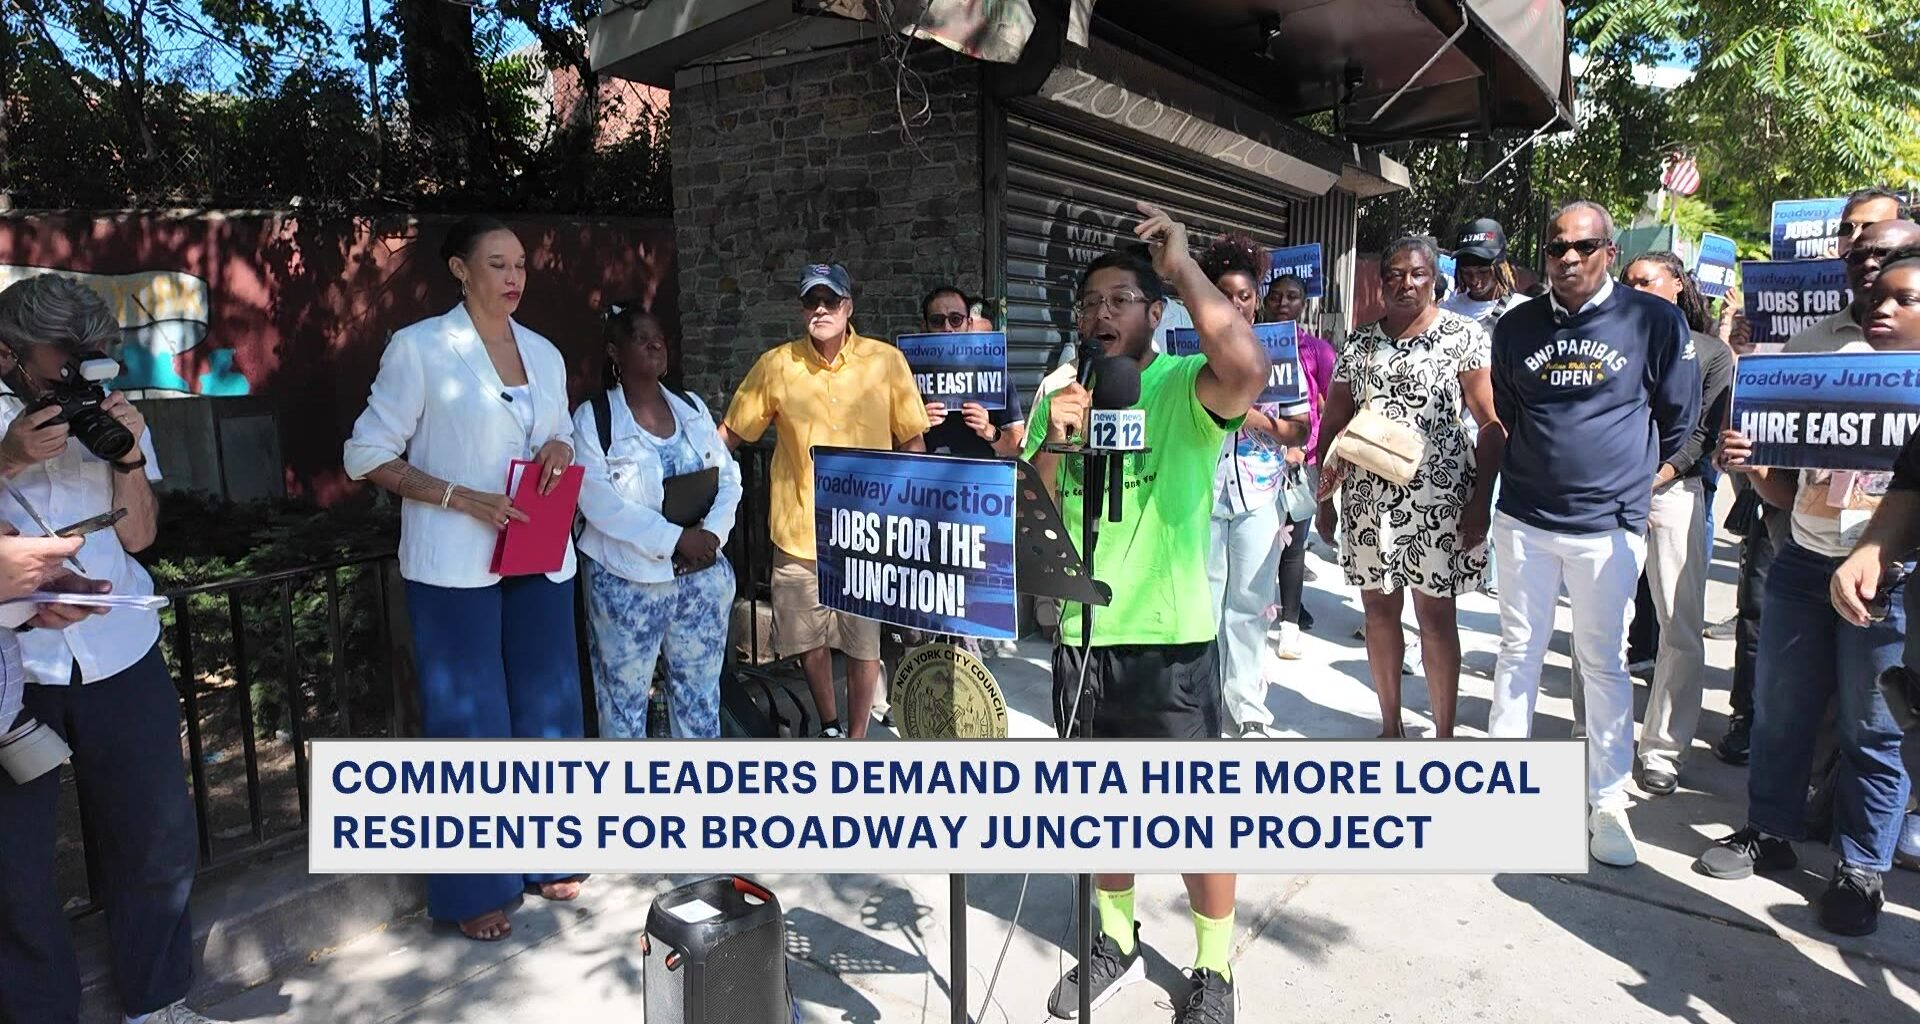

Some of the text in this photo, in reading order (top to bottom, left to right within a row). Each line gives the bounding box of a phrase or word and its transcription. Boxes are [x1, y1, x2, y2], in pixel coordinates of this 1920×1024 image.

[1775, 208, 1831, 219] roadway
[1783, 220, 1824, 240] JOBS
[1295, 264, 1313, 279] THE
[1744, 272, 1807, 288] roadway
[1757, 291, 1799, 313] JOBS
[1803, 290, 1841, 312] FOR
[902, 346, 945, 357] oadway
[1524, 339, 1628, 372] BNP PARIBAS
[913, 371, 1002, 395] IRE EAST NY!
[1550, 370, 1593, 386] OPEN
[1738, 369, 1920, 390] roadway Juncti
[1094, 413, 1117, 421] news
[1122, 413, 1143, 421] news
[1741, 411, 1801, 444] HIRE
[1805, 412, 1876, 446] EAST
[1093, 422, 1117, 447] 12
[1122, 422, 1142, 447] 12
[816, 473, 893, 507] roadway
[829, 507, 987, 570] JOBS FOR THE
[842, 556, 966, 618] JUNCTION!
[896, 649, 1005, 721] NEW YORK CITY COUNCIL
